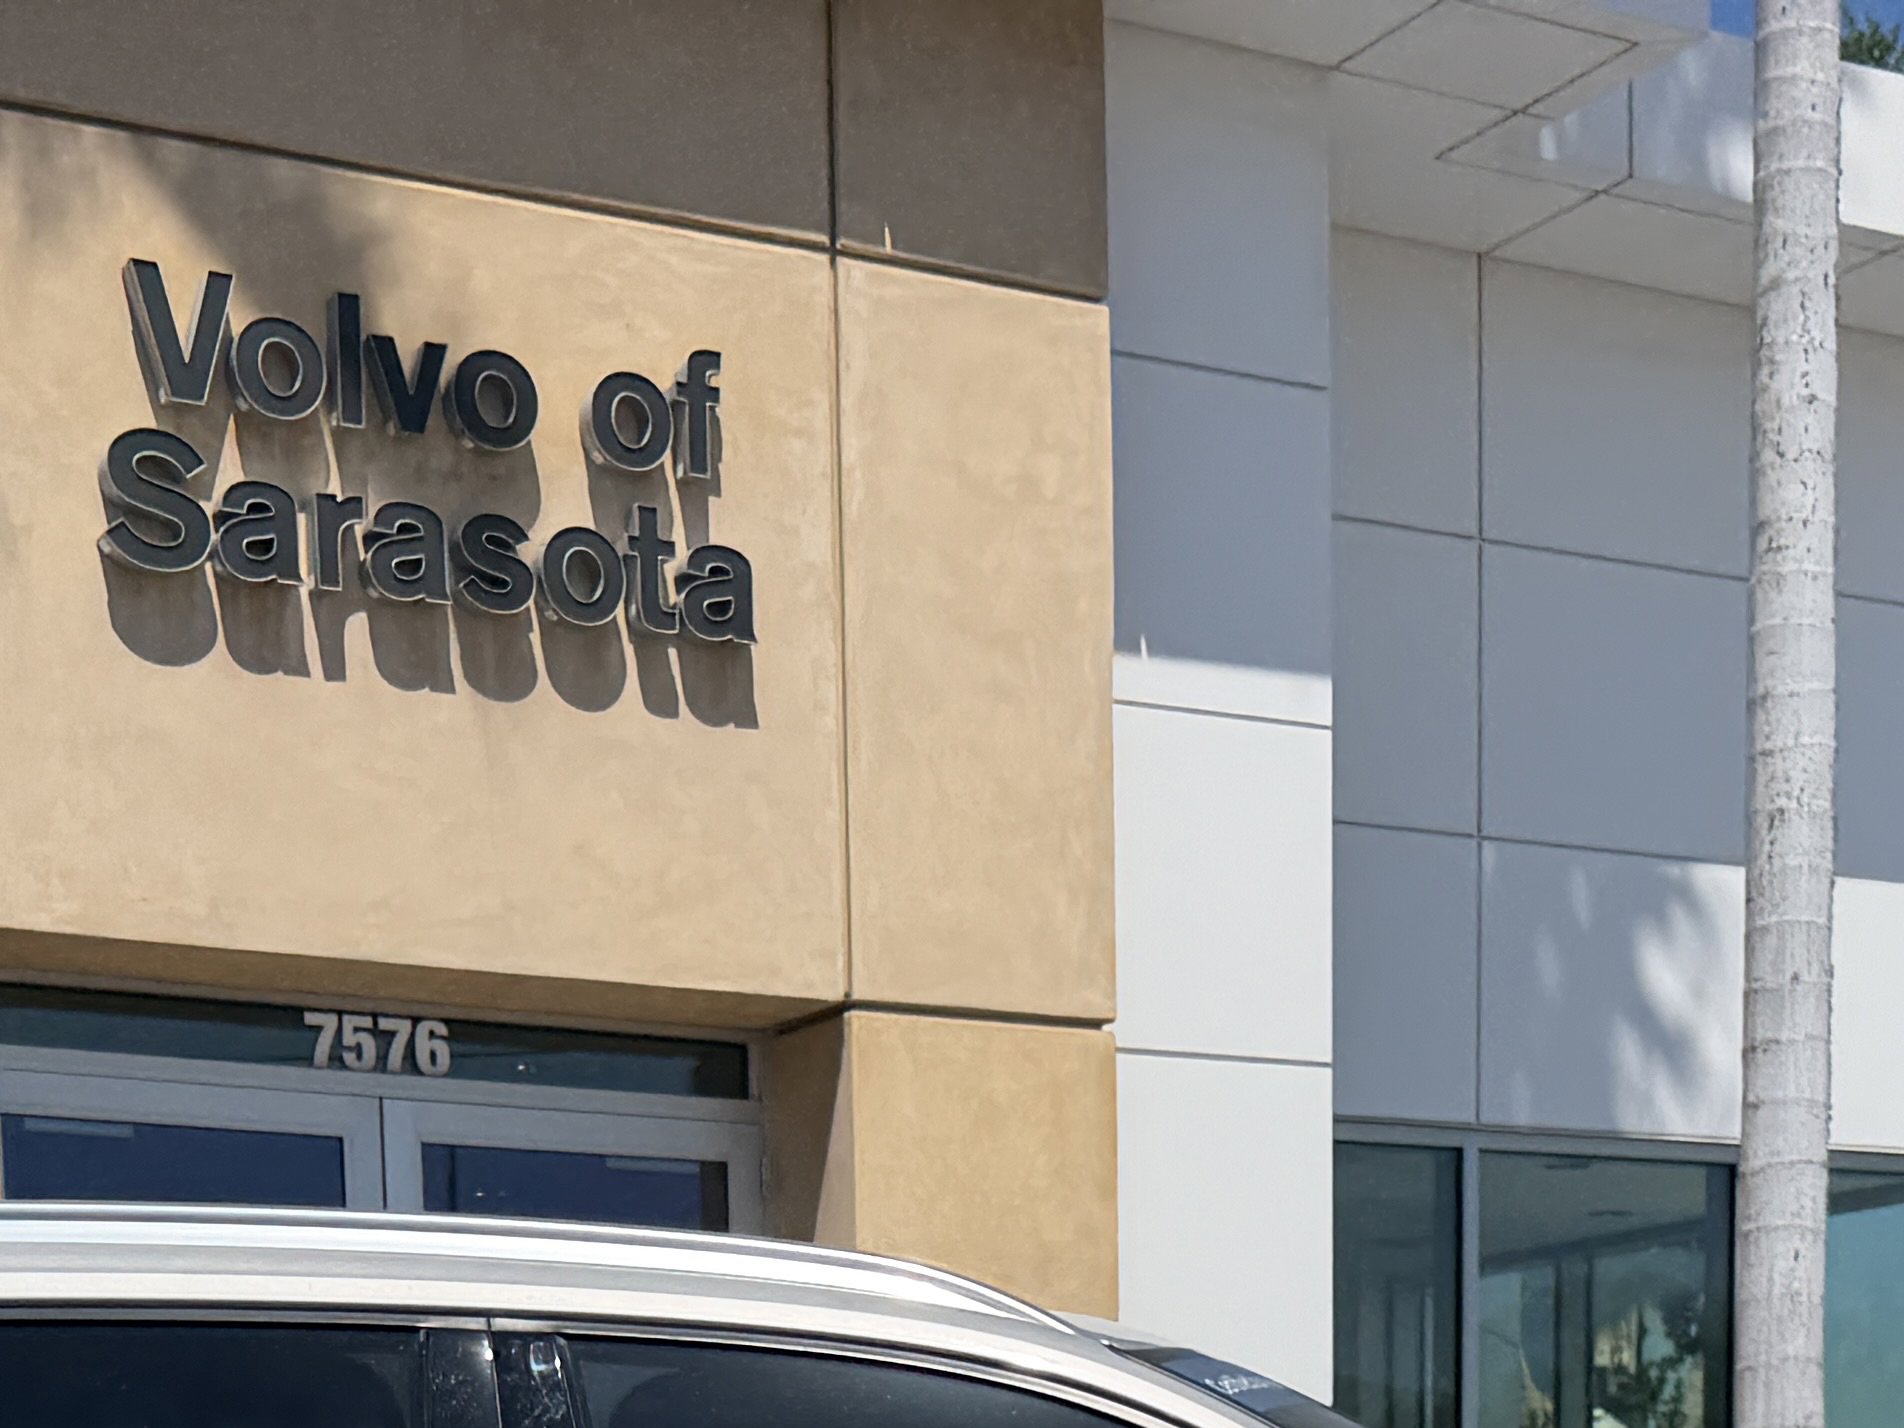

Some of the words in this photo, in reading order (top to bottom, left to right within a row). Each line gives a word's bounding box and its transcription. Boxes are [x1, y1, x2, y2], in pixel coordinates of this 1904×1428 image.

[123, 258, 538, 450] Volvo
[582, 349, 722, 478] of
[98, 427, 758, 643] Sarasota
[303, 1011, 451, 1077] 7576
